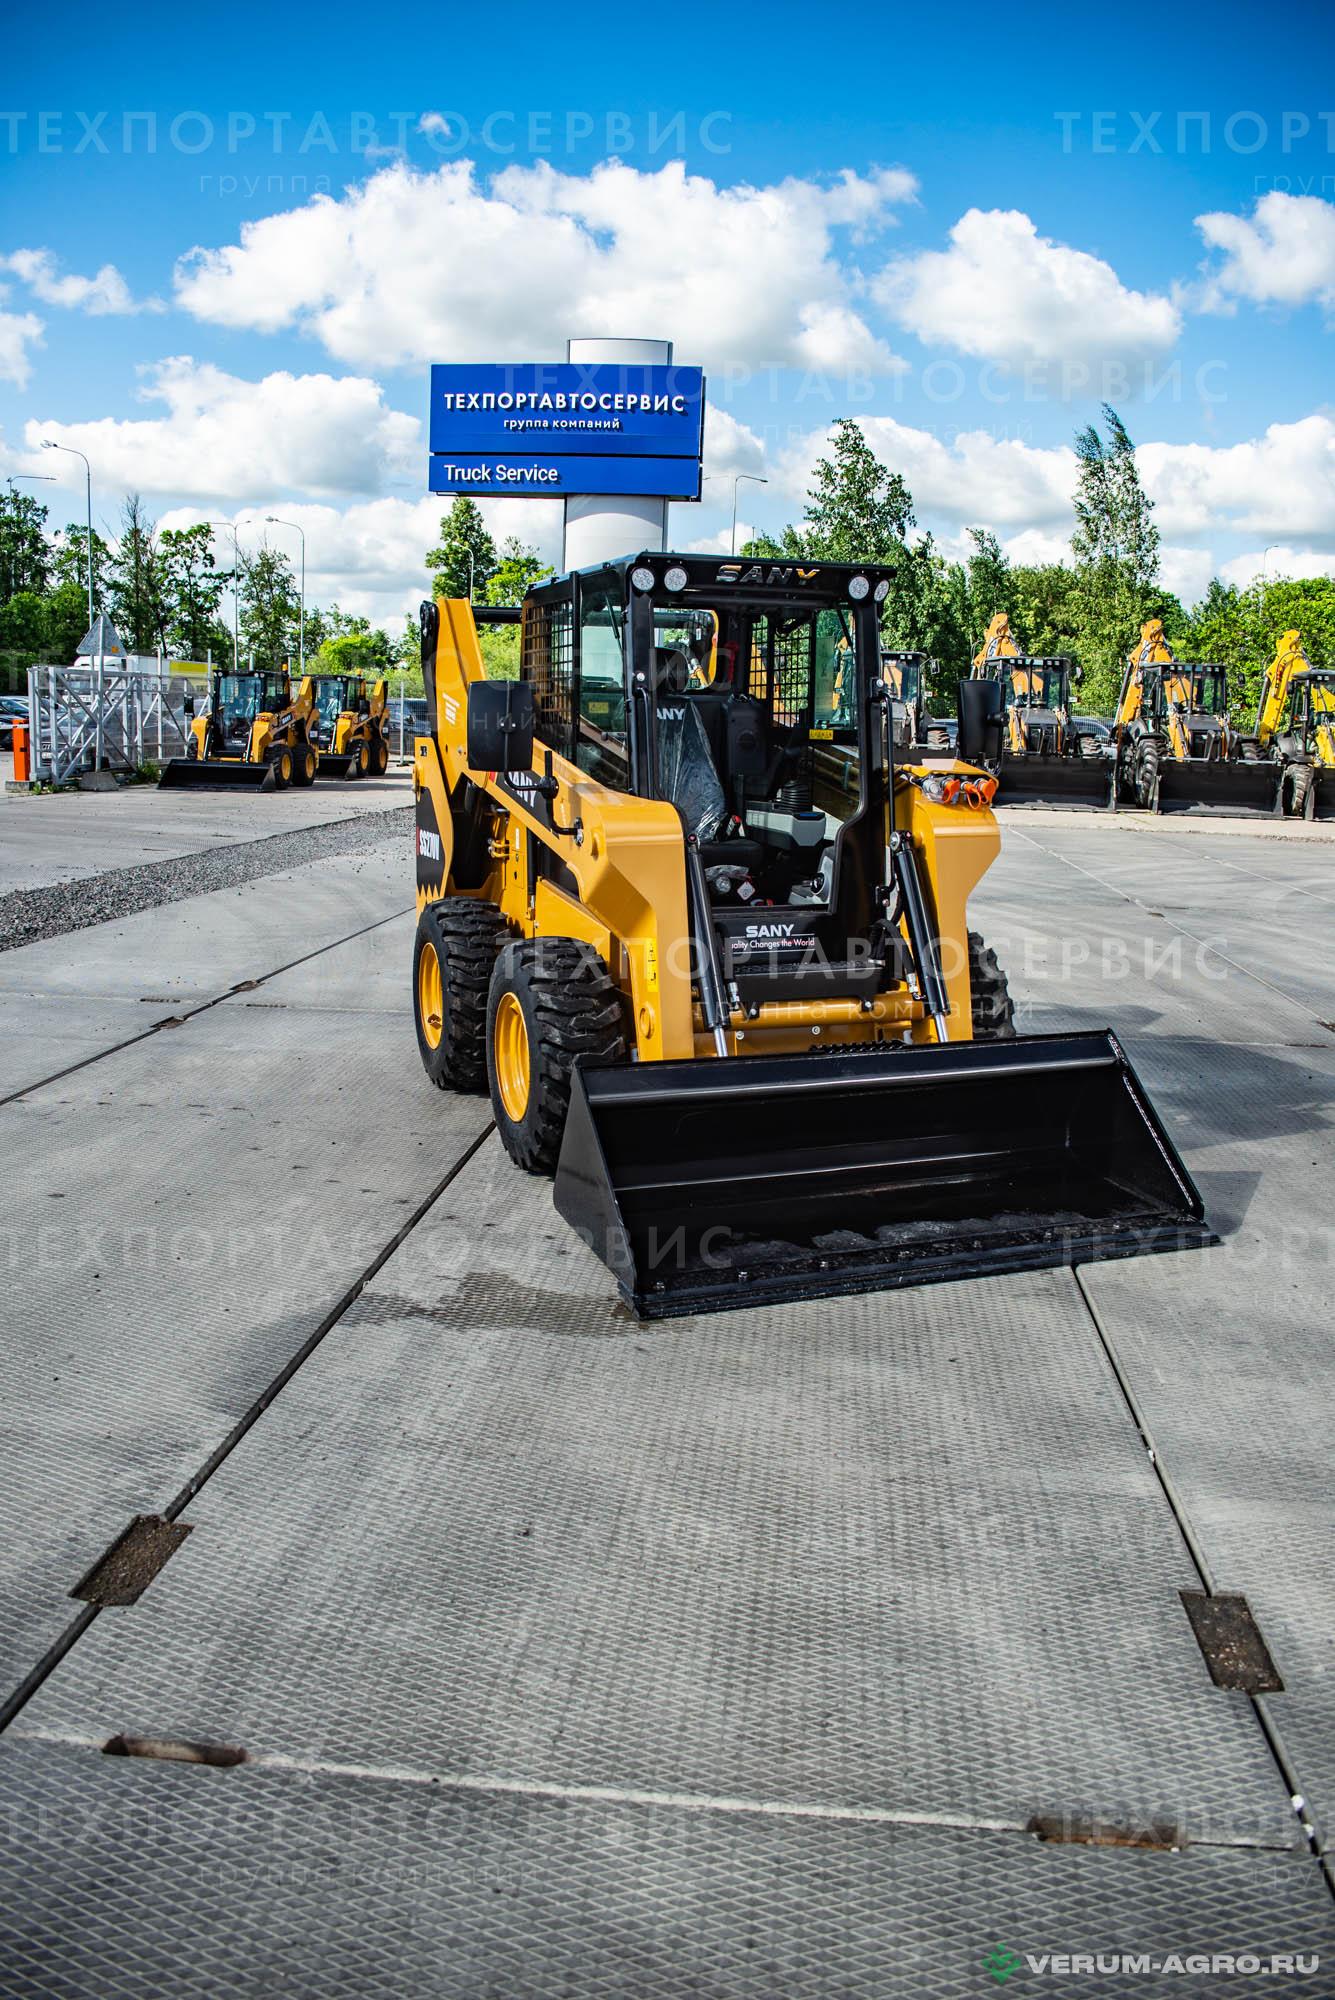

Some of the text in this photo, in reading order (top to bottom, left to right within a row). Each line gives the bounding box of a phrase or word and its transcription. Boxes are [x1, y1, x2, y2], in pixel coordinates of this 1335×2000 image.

[444, 393, 685, 412] ТЕХПОРТАВТОСЕРВИС
[503, 417, 620, 429] группа компаний
[444, 464, 558, 481] Truck Service
[716, 565, 820, 585] SANY
[656, 707, 685, 720] ANY
[745, 923, 795, 938] SANY
[732, 937, 815, 951] ality Changes the World
